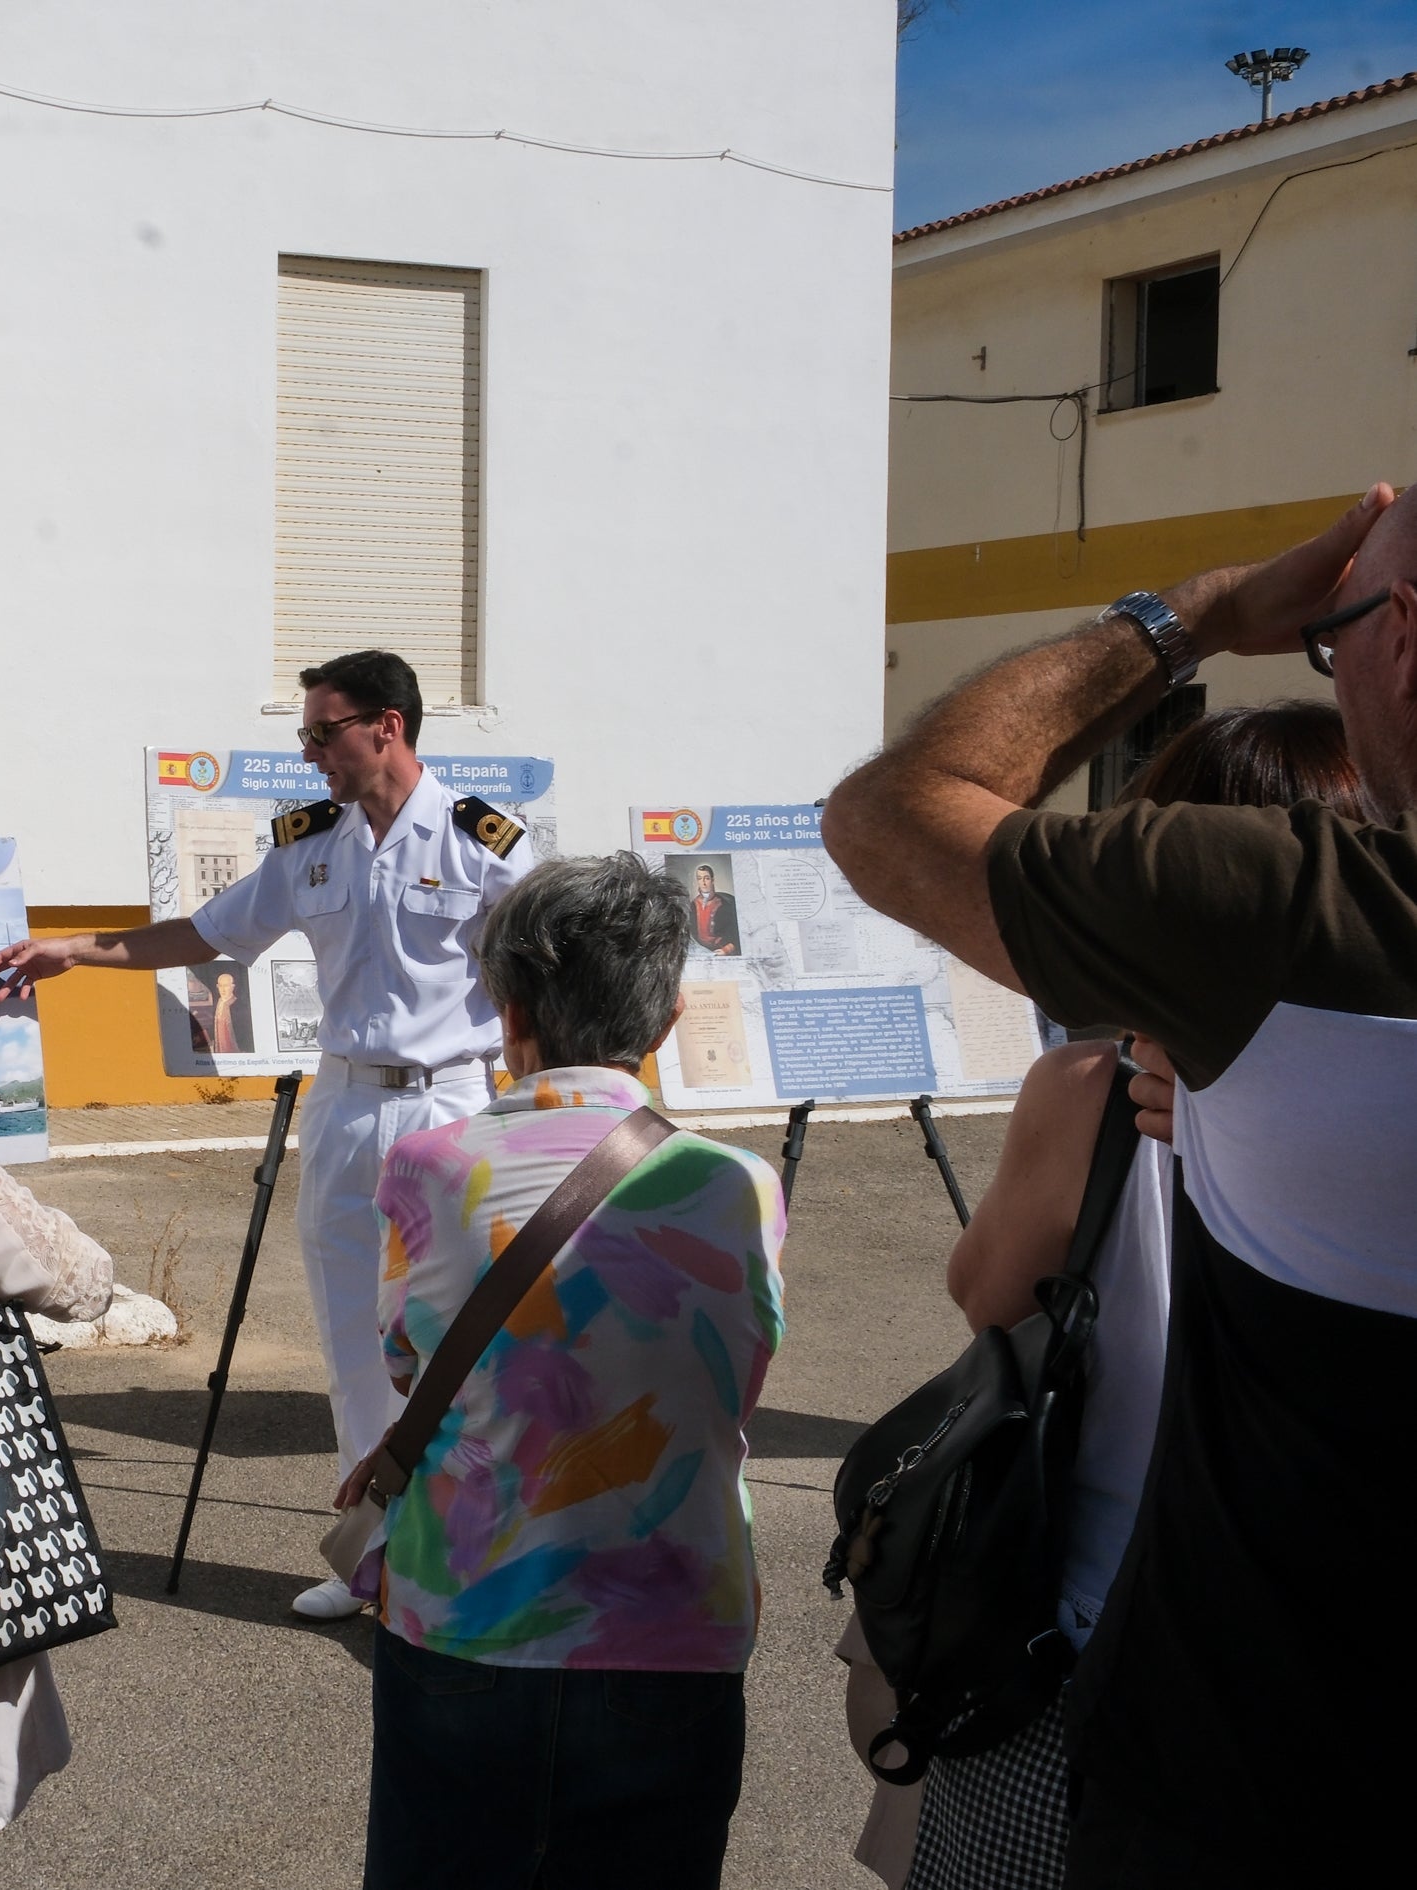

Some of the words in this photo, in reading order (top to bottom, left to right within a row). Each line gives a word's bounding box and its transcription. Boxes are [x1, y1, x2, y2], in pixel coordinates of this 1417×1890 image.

[243, 758, 271, 773] 225
[274, 759, 313, 774] años
[451, 763, 508, 780] España
[241, 778, 269, 791] Siglo
[271, 778, 296, 790] XVIII
[305, 779, 319, 790] La
[453, 782, 512, 795] Hidrografía
[726, 814, 751, 828] 225
[755, 813, 790, 827] años
[793, 812, 811, 826] de
[724, 830, 751, 843] Siglo
[753, 830, 771, 841] XIX
[779, 830, 793, 840] La
